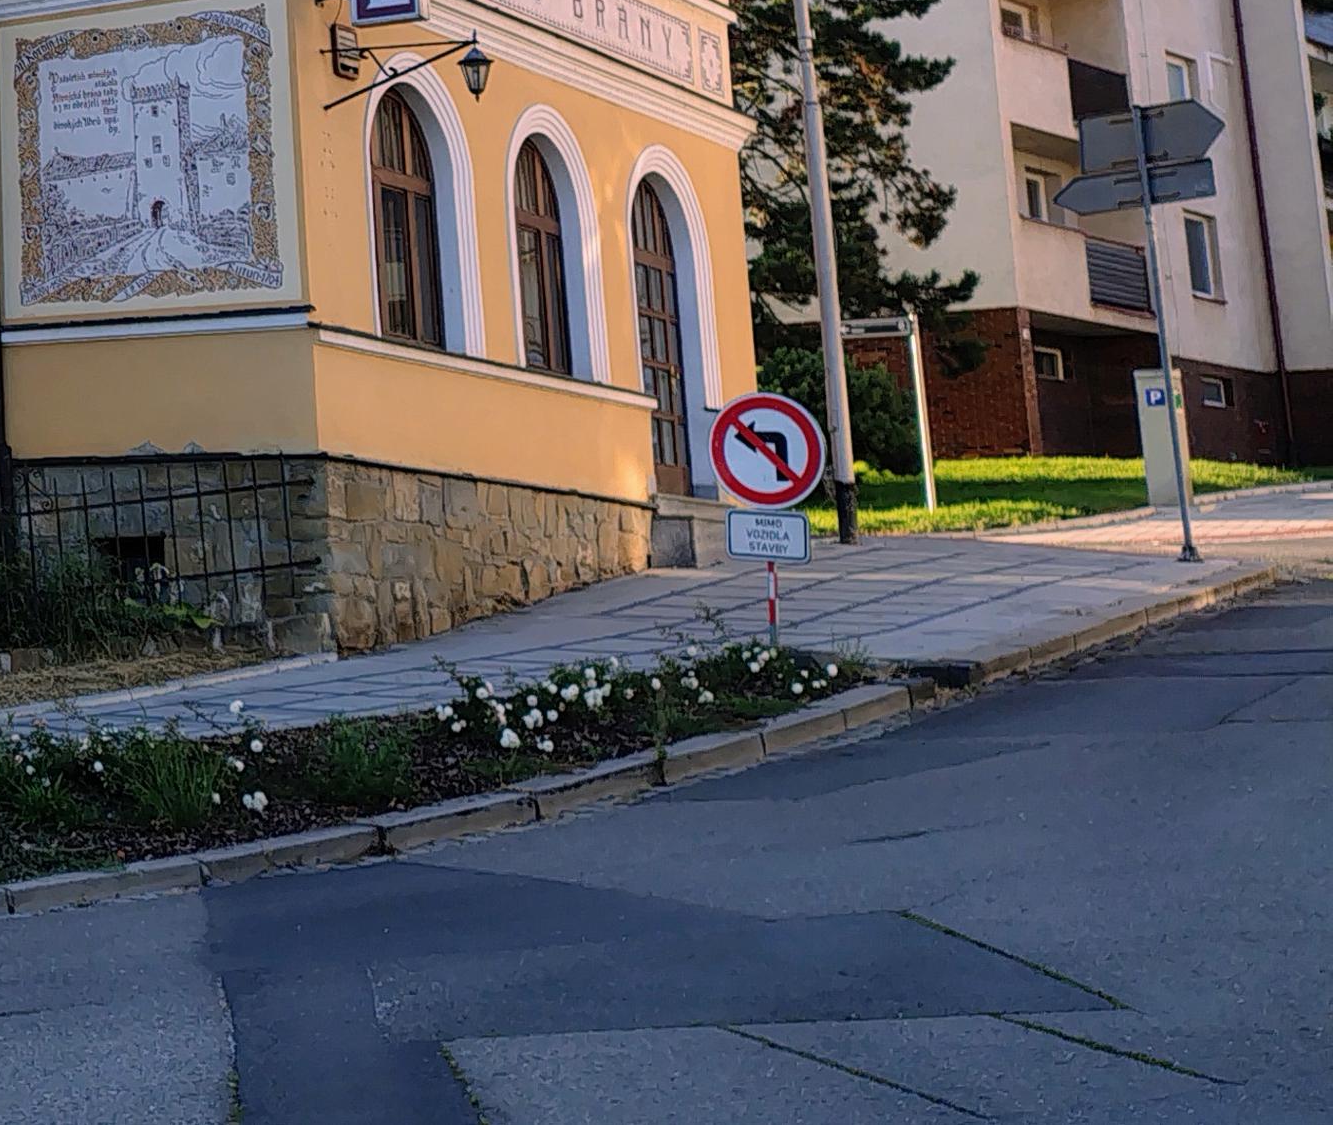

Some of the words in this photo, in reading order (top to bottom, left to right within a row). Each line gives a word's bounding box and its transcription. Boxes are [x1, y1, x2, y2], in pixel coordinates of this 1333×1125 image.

[1150, 390, 1162, 405] P
[755, 518, 783, 528] MIMO
[746, 528, 790, 542] VOZIDLA
